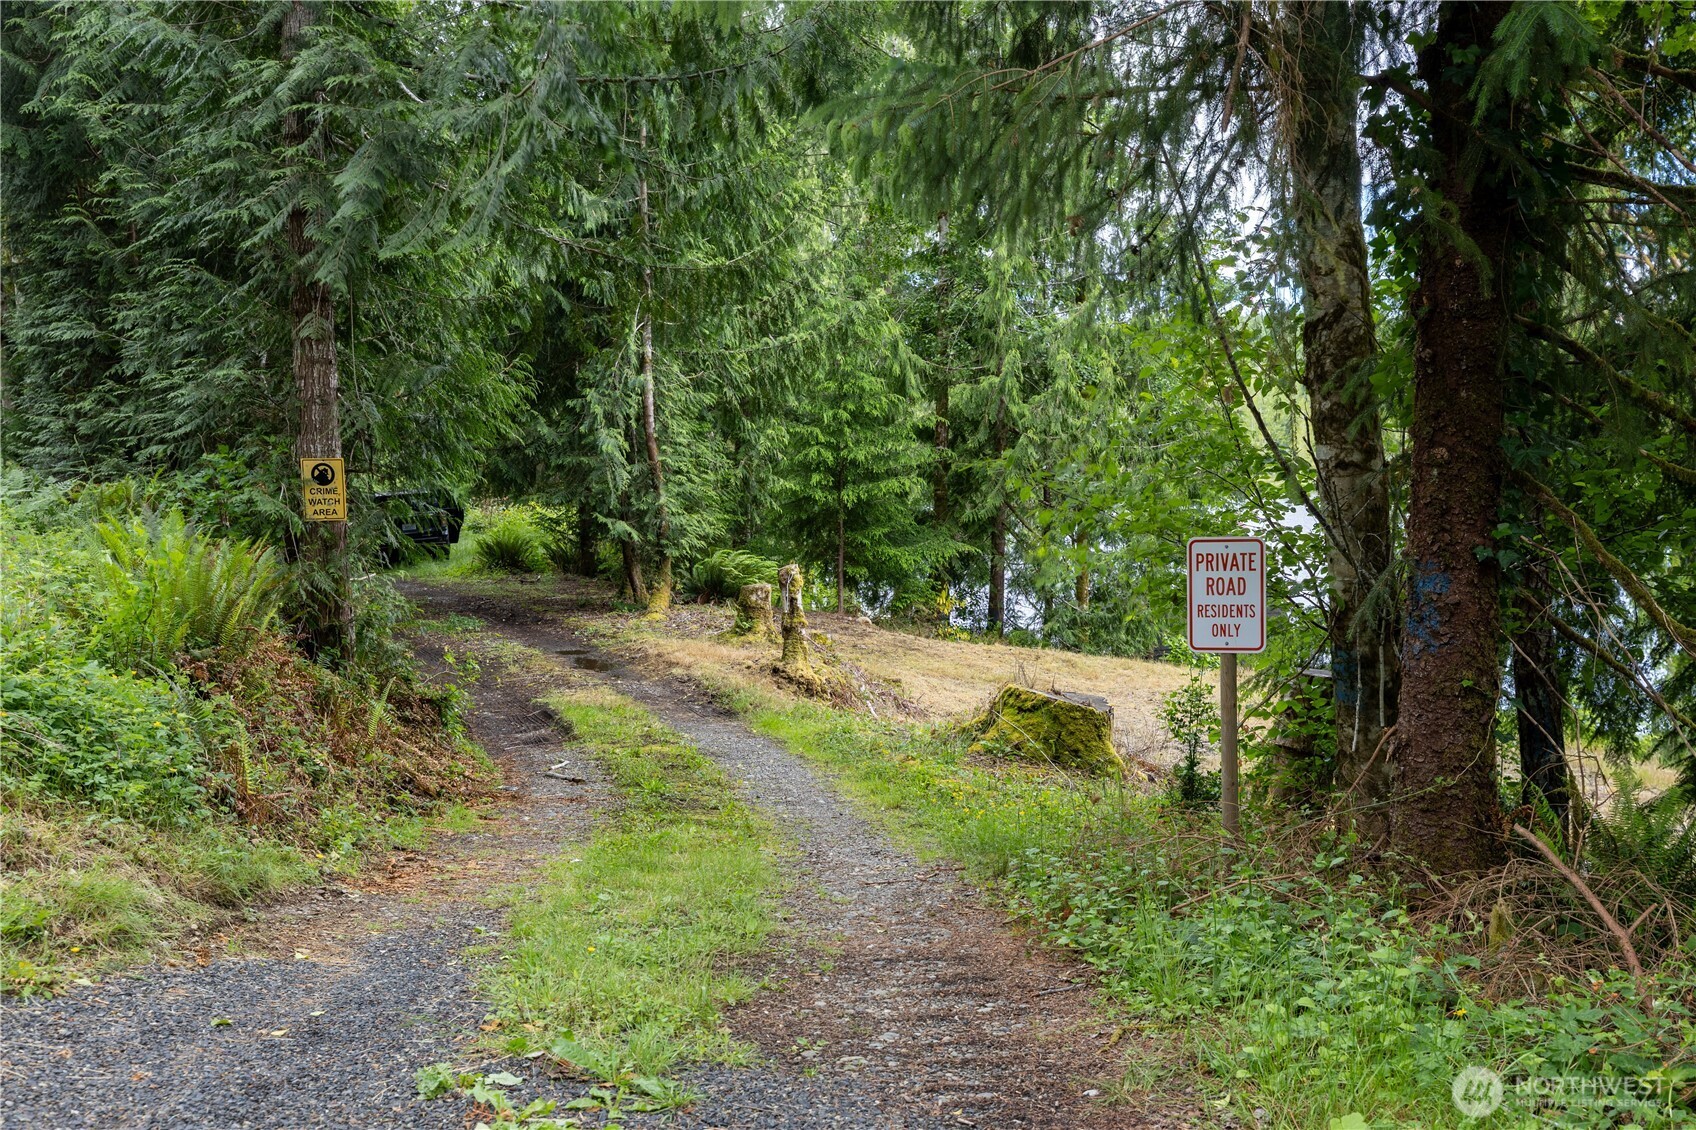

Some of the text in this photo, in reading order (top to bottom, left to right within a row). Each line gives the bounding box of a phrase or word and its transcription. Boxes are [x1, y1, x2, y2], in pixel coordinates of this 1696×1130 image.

[309, 487, 339, 495] CRIME
[308, 498, 341, 506] WATCH
[312, 508, 338, 516] AREA
[1195, 552, 1257, 572] PRIVATE
[1206, 577, 1247, 596] ROAD
[1197, 604, 1256, 618] RESIDENTS
[1211, 623, 1241, 638] ONLY
